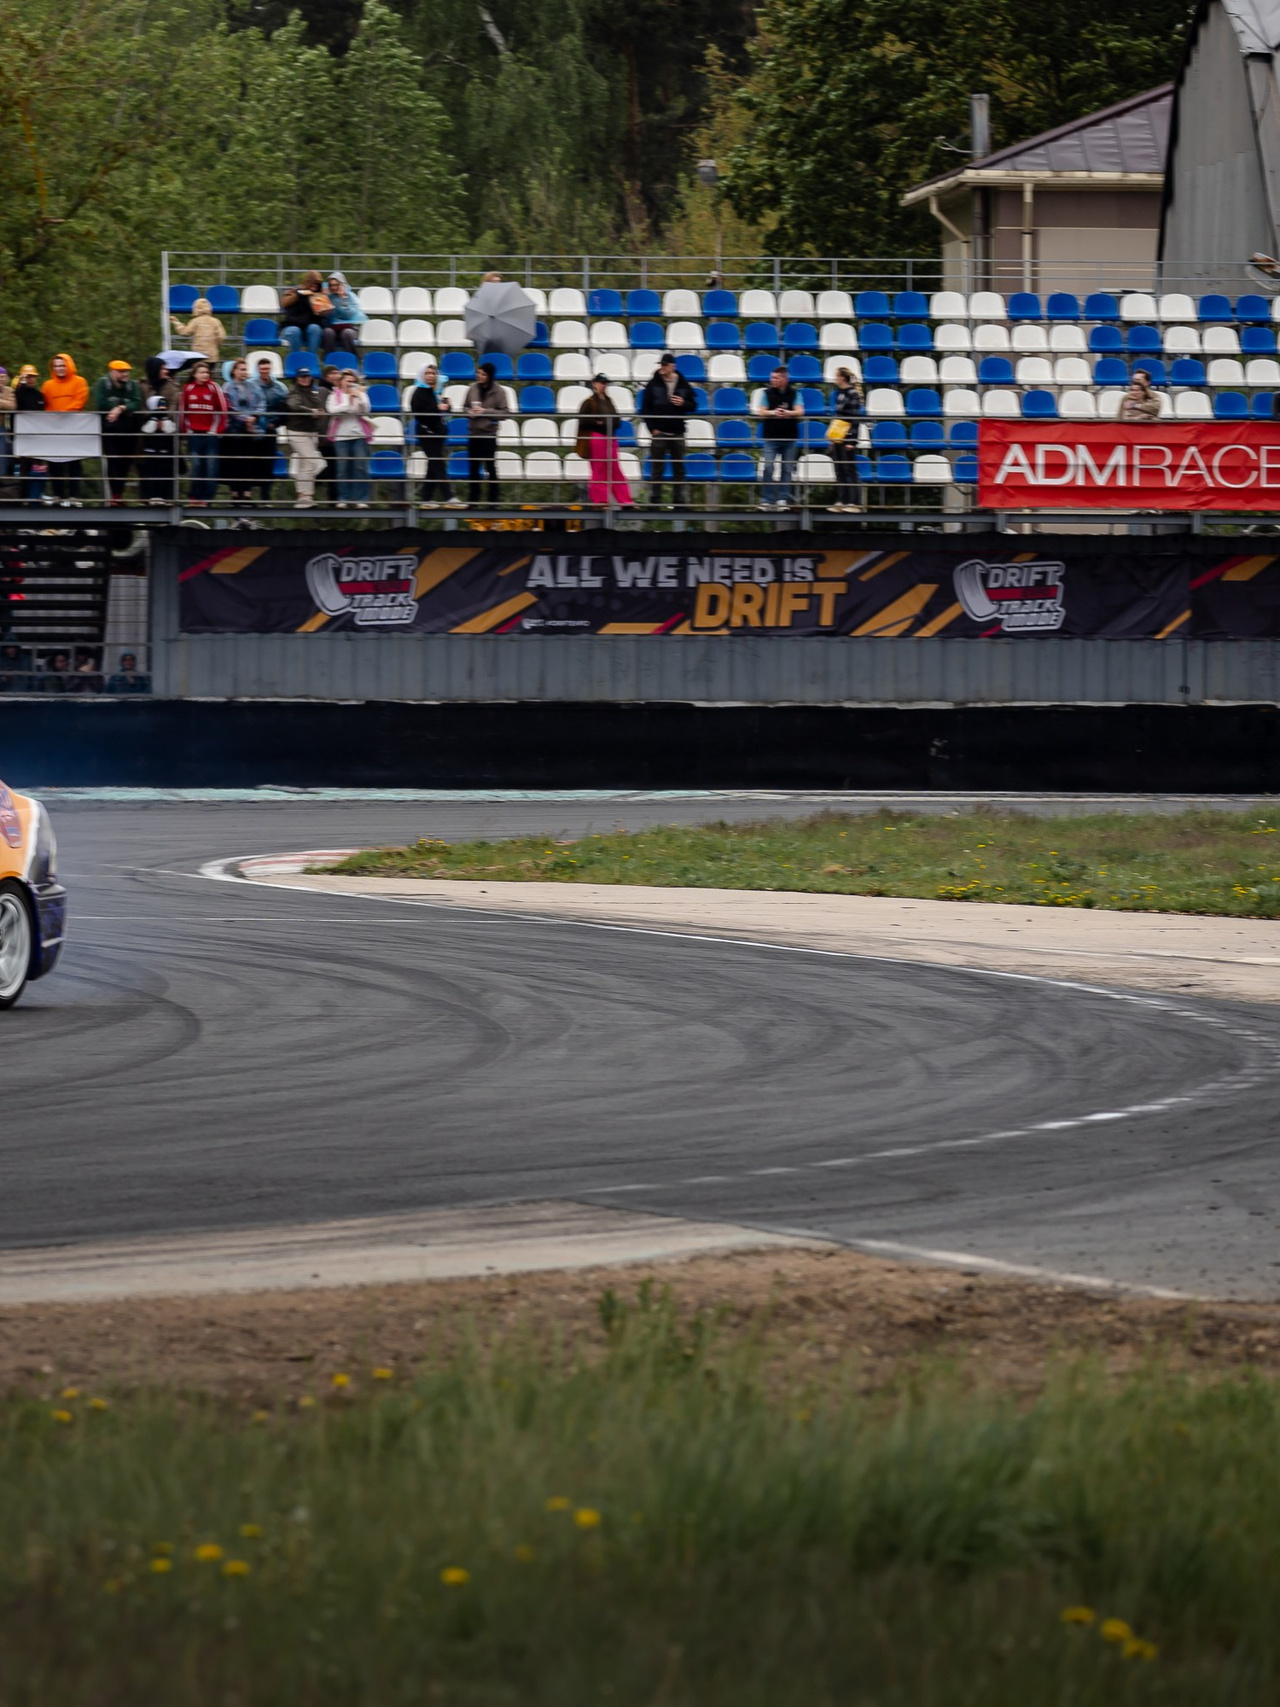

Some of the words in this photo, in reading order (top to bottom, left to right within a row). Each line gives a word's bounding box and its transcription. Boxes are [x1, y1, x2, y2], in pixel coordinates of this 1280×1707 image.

[340, 561, 412, 582] DRIFT
[525, 555, 607, 588] ALL
[612, 555, 681, 588] WE
[686, 556, 777, 587] NEED
[783, 557, 816, 582] IS
[987, 567, 1059, 588] DRIFT
[693, 581, 848, 628] DRIFT
